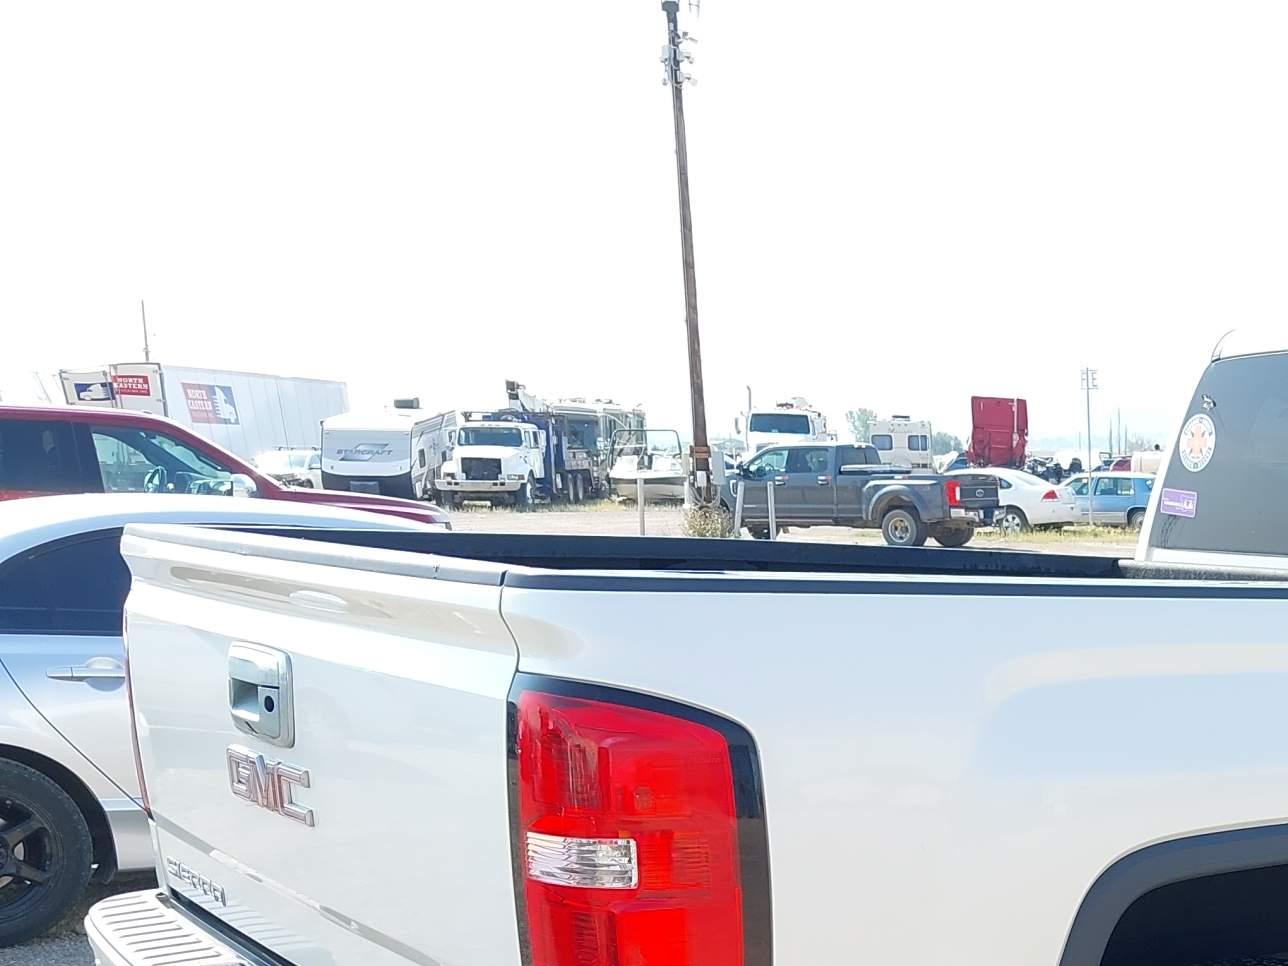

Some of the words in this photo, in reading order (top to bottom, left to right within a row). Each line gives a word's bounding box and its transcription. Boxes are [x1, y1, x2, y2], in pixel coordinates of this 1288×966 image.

[336, 448, 393, 456] STARCRAFT
[226, 743, 315, 827] GMC
[166, 855, 227, 908] SIERRA
